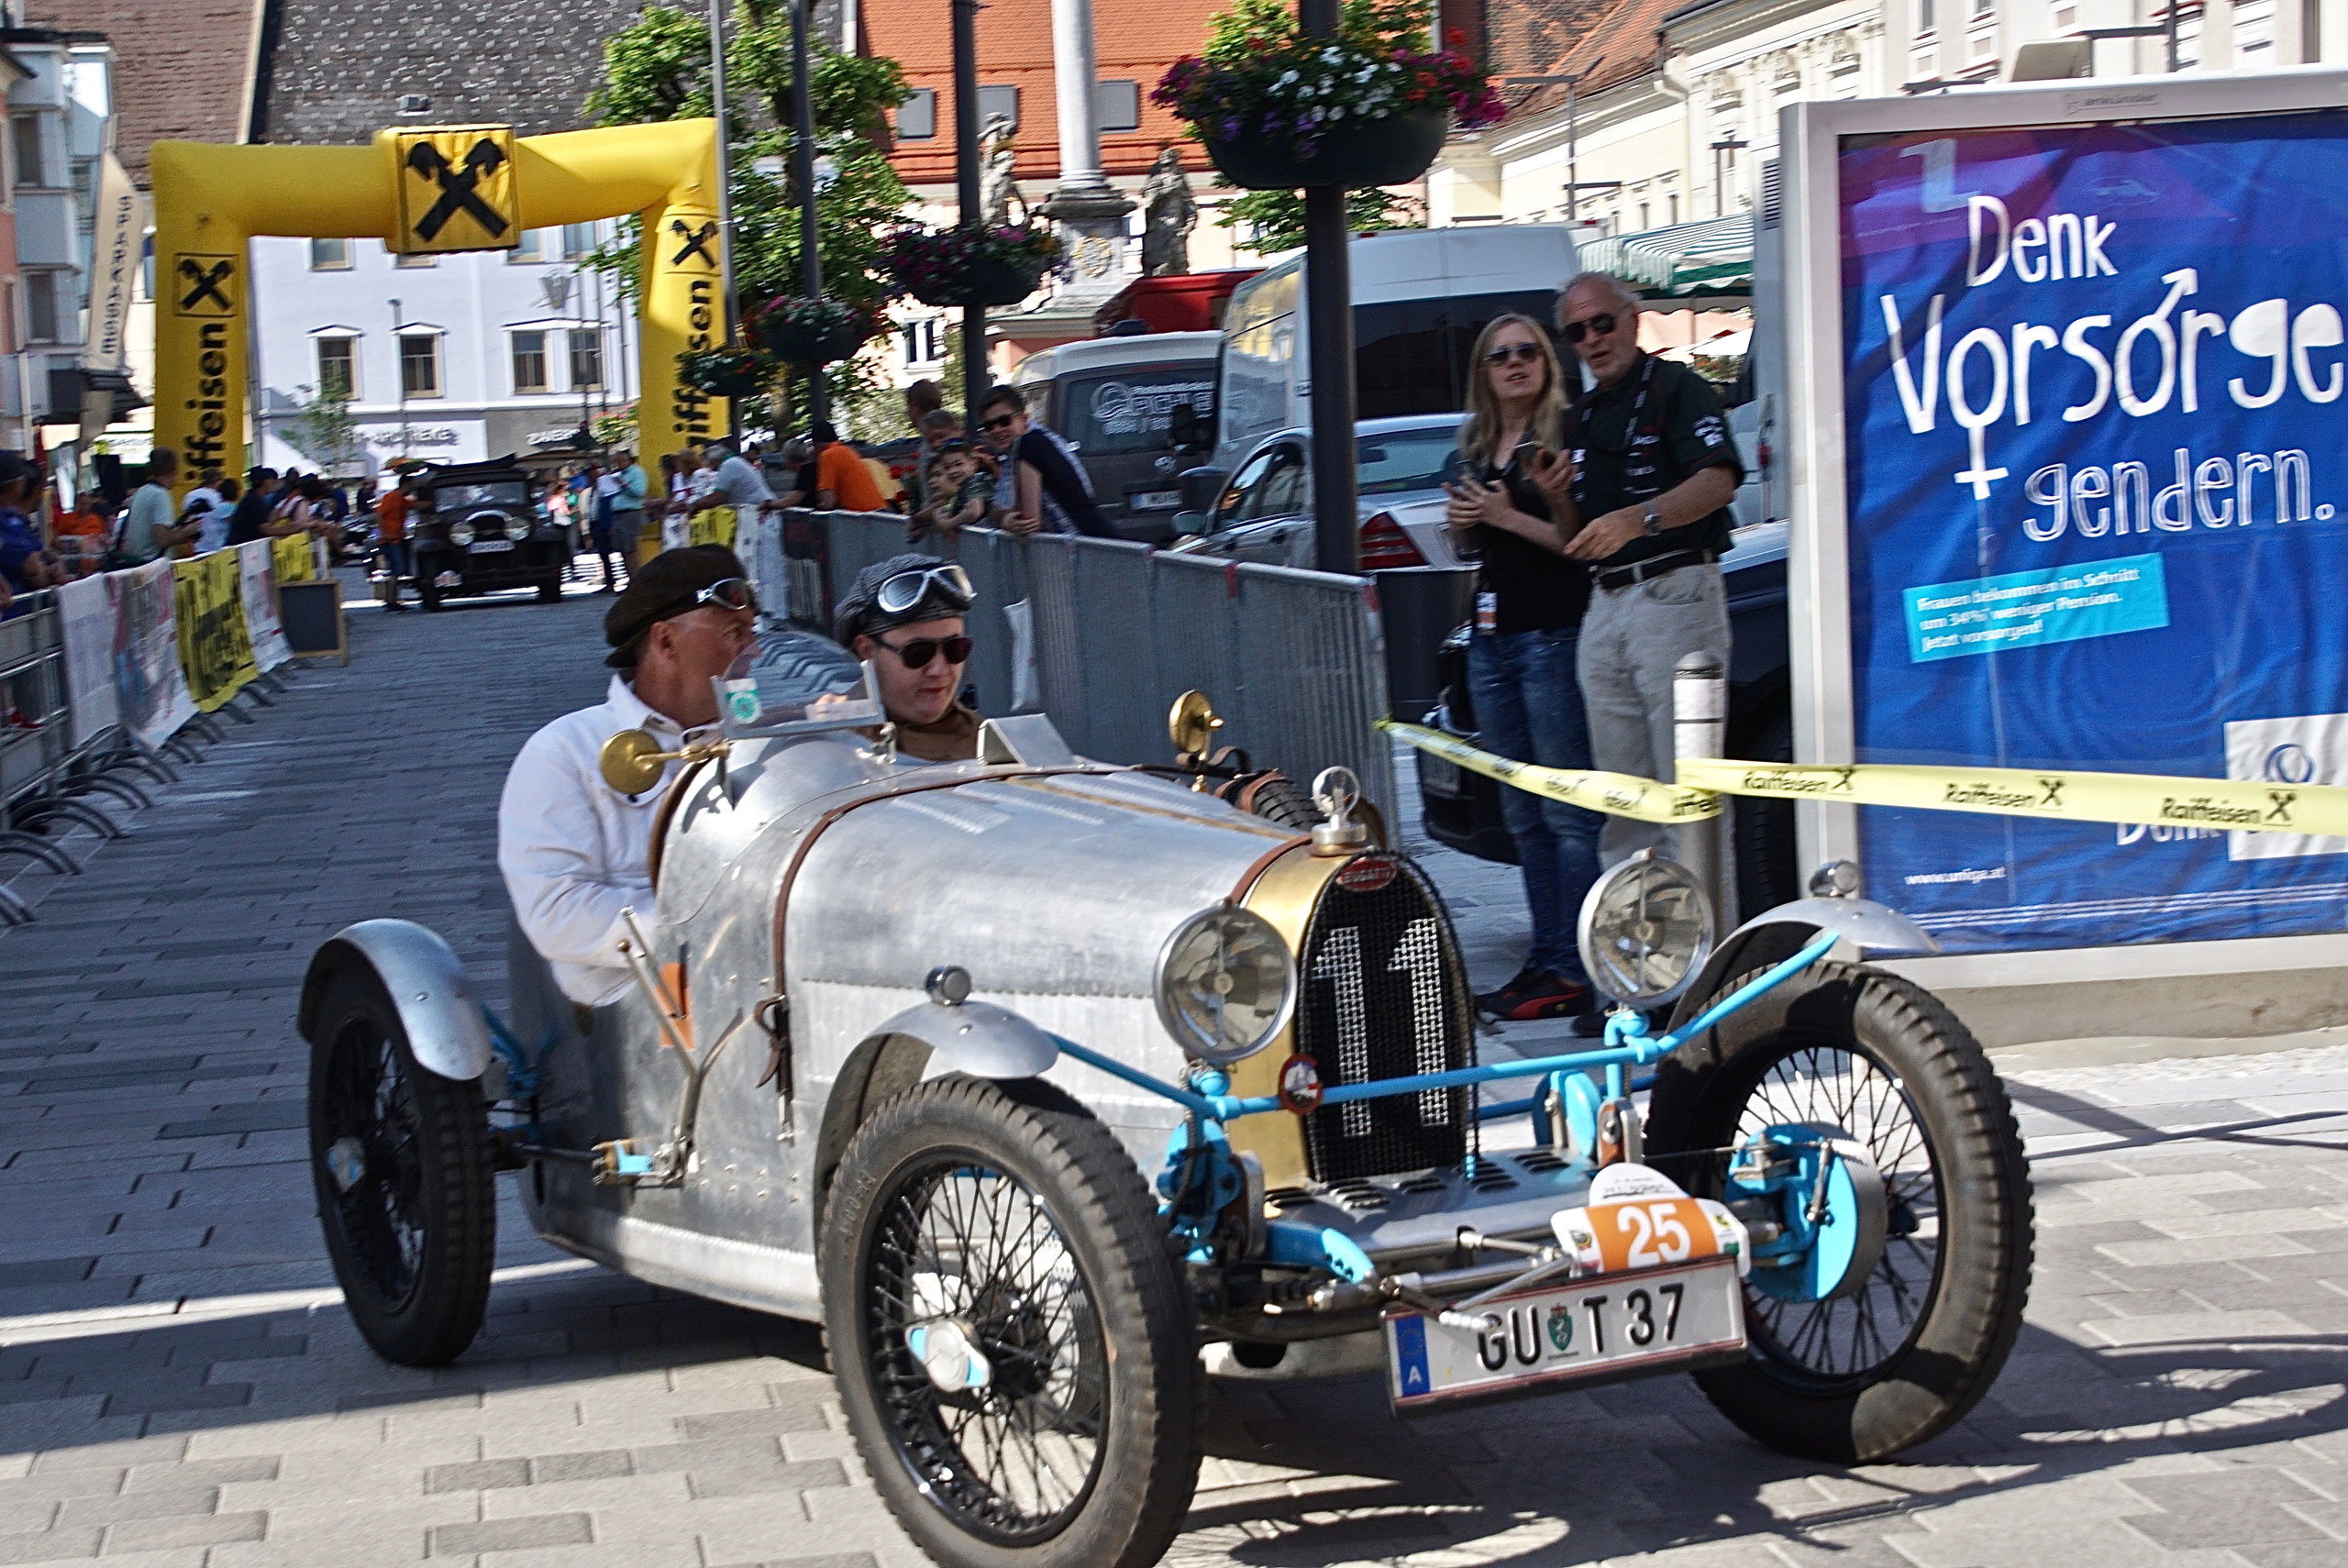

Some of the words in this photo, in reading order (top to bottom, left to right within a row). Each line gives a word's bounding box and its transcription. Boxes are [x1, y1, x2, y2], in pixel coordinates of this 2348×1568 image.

[1966, 196, 2120, 287] Denk
[1879, 268, 2345, 498] Vorsorge
[2022, 447, 2336, 543] gendern.
[1917, 596, 1971, 612] Frauen
[1972, 582, 2058, 603] bekommen
[2059, 577, 2083, 591] im
[2083, 568, 2141, 588] Schnitt
[1920, 617, 1948, 630] um
[1990, 602, 2055, 620] weniger
[1922, 634, 1959, 652] Jetzt
[1961, 619, 2043, 642] vorsorgen!
[1742, 769, 1828, 793] Raiffeisen
[1942, 782, 2036, 810] Raiffeisen
[2159, 795, 2261, 825] Raiffeisen
[1312, 918, 1449, 1137] 11
[1616, 1203, 1691, 1268] 25
[1478, 1304, 1543, 1373] GU
[1582, 1295, 1609, 1354] T
[1624, 1283, 1685, 1347] 37
[1408, 1365, 1423, 1385] A
